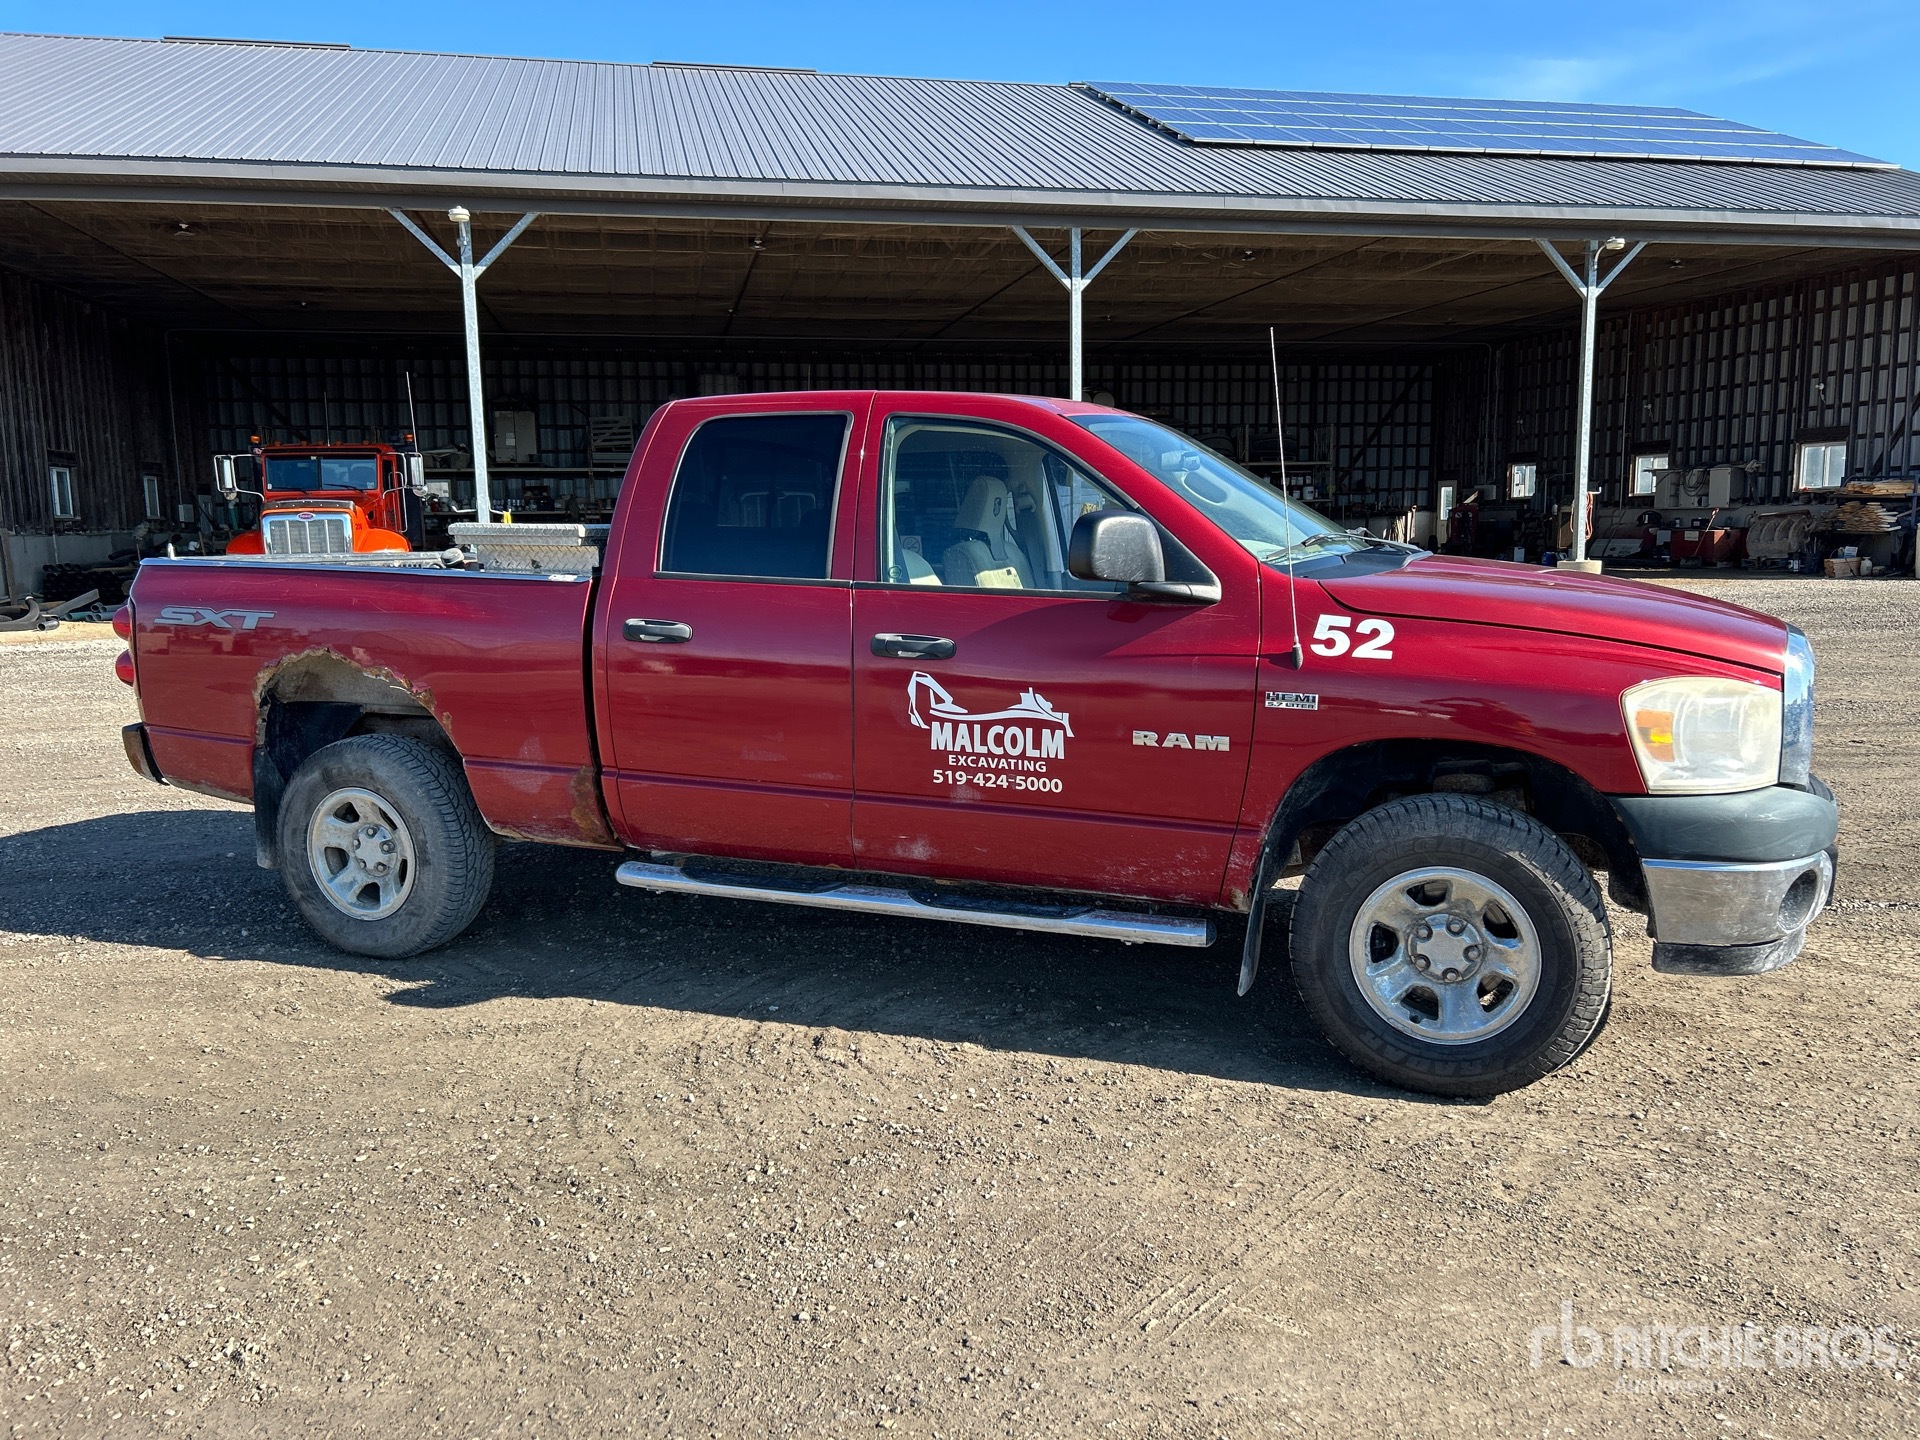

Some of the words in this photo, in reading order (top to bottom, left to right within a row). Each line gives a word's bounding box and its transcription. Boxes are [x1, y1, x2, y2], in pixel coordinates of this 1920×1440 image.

[154, 606, 276, 630] SXT
[1309, 613, 1396, 660] 52
[1266, 692, 1317, 703] HEMI
[930, 721, 1065, 760] MALCOLM
[1132, 730, 1230, 752] RAM
[948, 754, 1047, 773] EXCAVATING
[932, 769, 1063, 793] 519-424-5000
